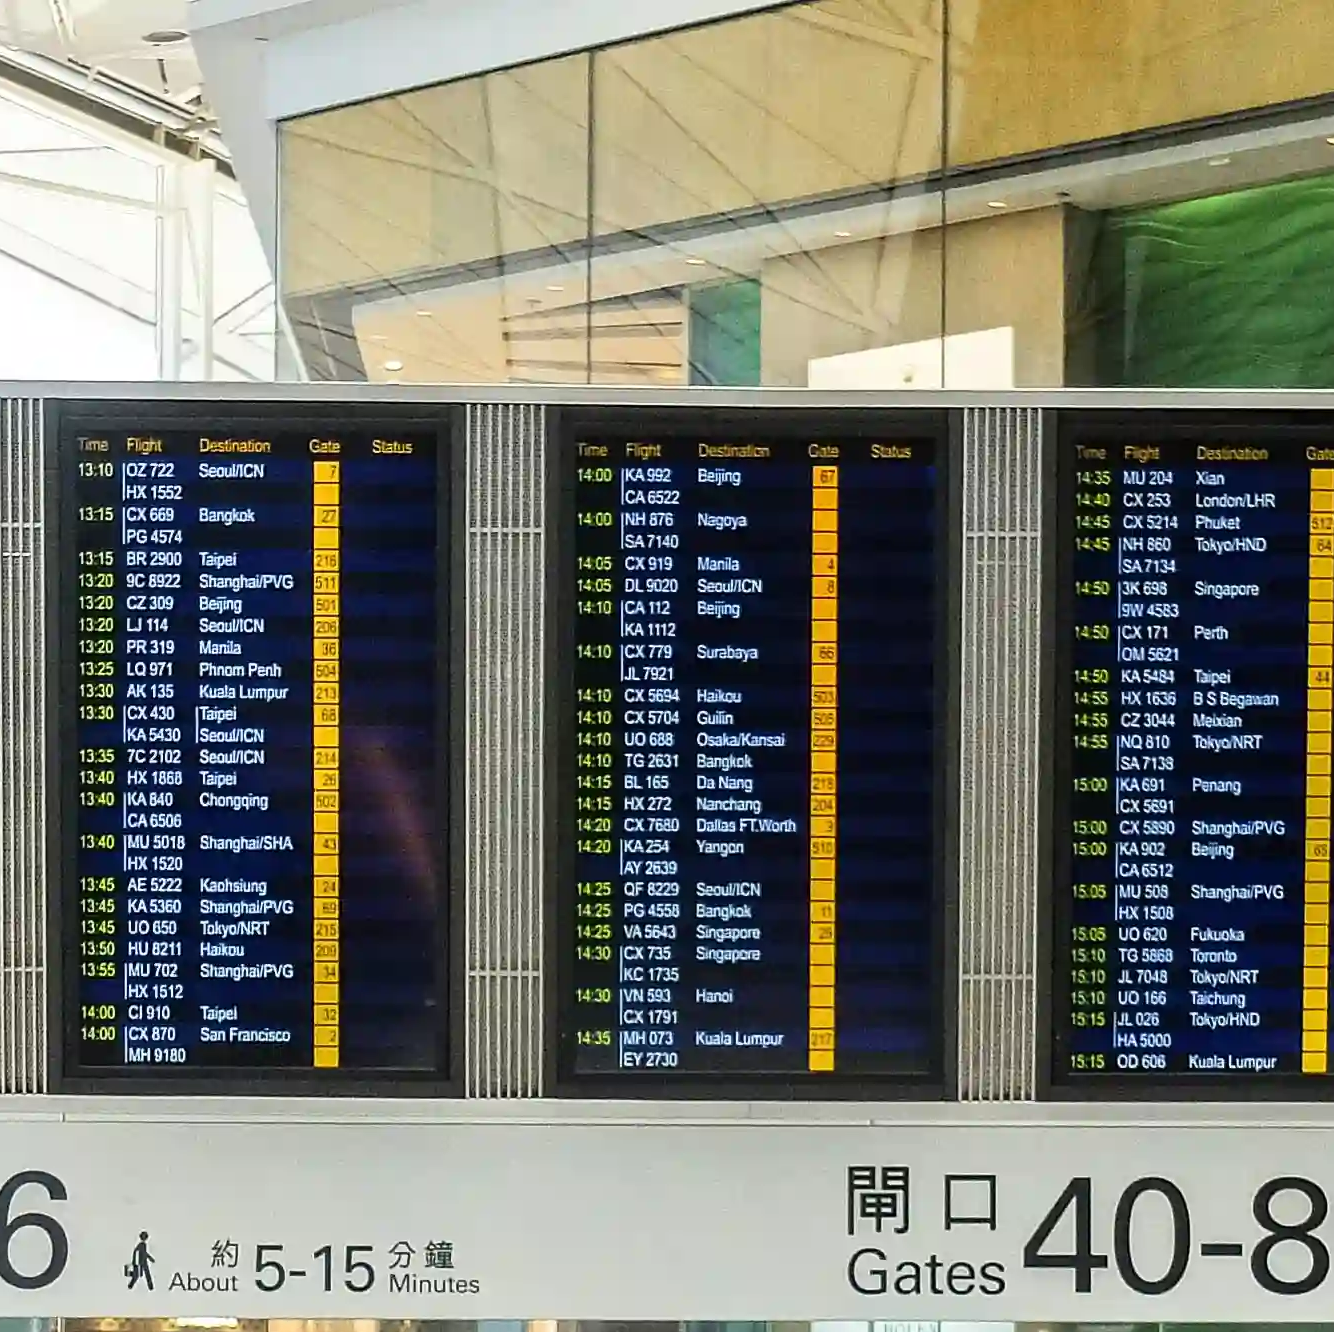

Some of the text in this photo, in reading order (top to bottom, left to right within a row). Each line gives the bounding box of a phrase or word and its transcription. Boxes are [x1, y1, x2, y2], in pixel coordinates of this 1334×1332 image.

[127, 437, 163, 455] Flight
[199, 438, 271, 453] Destination
[309, 440, 341, 453] Gate
[372, 441, 413, 454] Status
[79, 462, 265, 478] 13:10 OZ 722 Seoul/ICN
[578, 511, 748, 530] 14:00 NH 876 Nagoya
[1195, 514, 1241, 530] Phuket
[79, 573, 114, 588] 13:20
[126, 573, 146, 588] 9C
[148, 573, 182, 589] 8922
[199, 573, 294, 593] Shanghai/PVG
[577, 578, 762, 593] 14:05 DL 9020 Seoul/ICN
[79, 661, 282, 678] 13:25 LQ 971 Phnom Penh
[696, 796, 762, 815] Nanchang
[1189, 1011, 1261, 1030] Tokyo/HND
[695, 1031, 733, 1046] Kuala
[735, 1031, 785, 1049] Lumpur
[847, 1165, 997, 1236] 閘口
[210, 1239, 455, 1270] 約 分鐘
[168, 1244, 480, 1294] About 5-15 Minutes
[847, 1247, 1006, 1296] Gates
